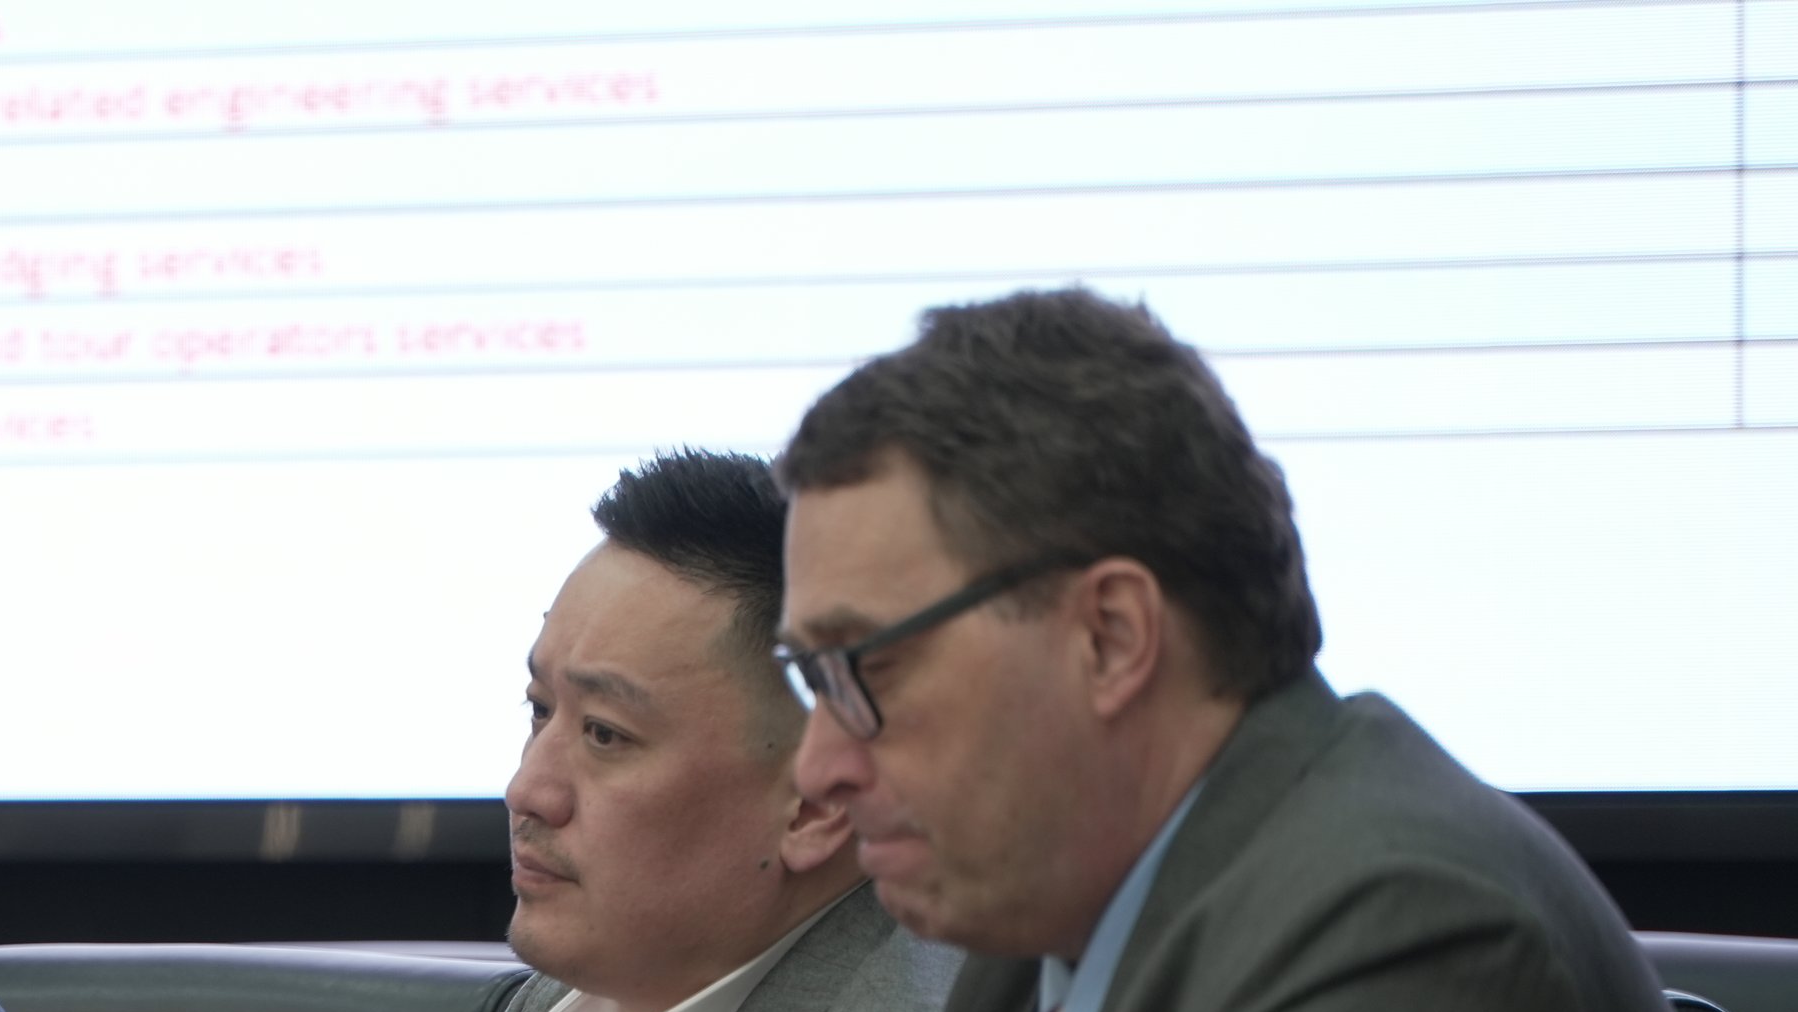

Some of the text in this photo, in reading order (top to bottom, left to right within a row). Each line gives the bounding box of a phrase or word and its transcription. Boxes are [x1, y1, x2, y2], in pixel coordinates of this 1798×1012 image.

[165, 74, 450, 134] engineering
[468, 70, 660, 110] services
[139, 245, 323, 280] services
[40, 327, 132, 363] tour
[151, 322, 378, 377] operators
[398, 320, 587, 356] services
